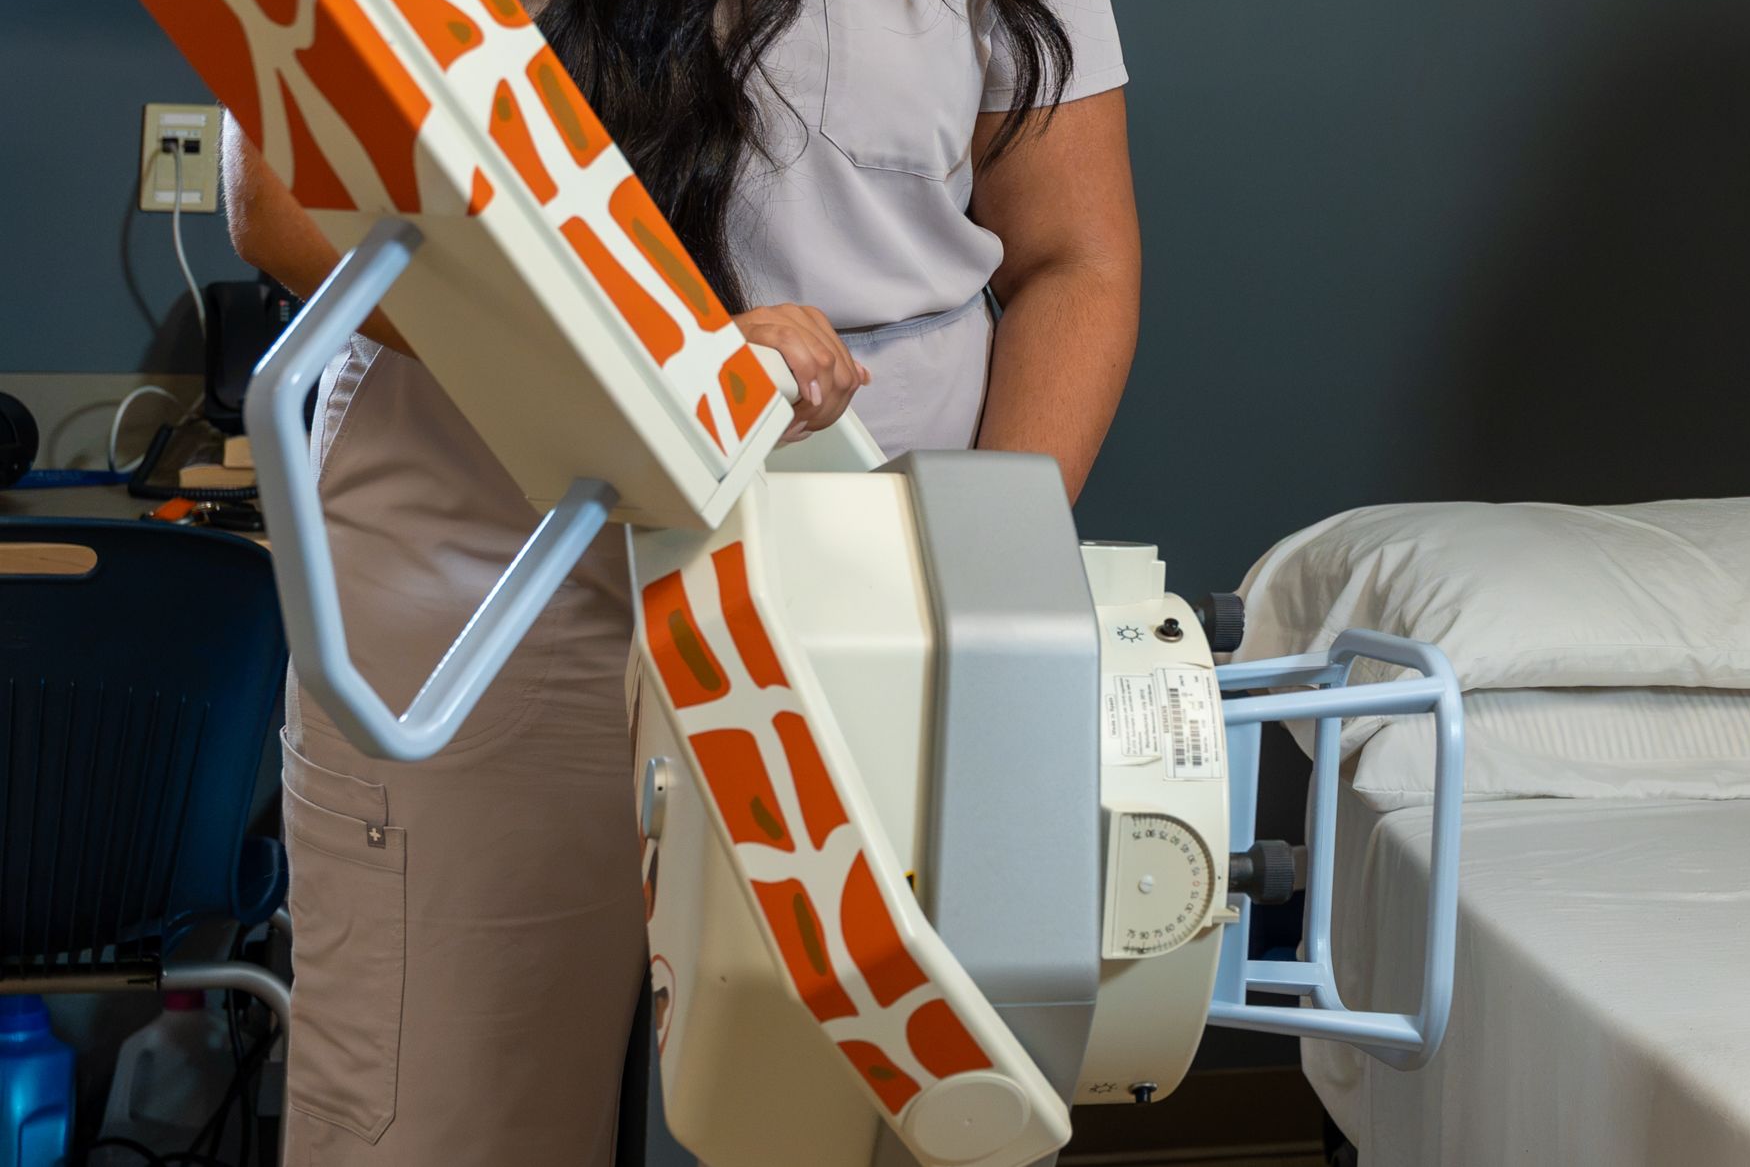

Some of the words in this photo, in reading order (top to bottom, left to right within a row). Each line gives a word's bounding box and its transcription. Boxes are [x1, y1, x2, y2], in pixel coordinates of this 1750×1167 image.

[1132, 832, 1141, 840] 75
[1146, 829, 1155, 838] 90
[1159, 831, 1168, 840] 75
[1170, 835, 1180, 845] 60
[1180, 843, 1190, 853] 45
[1187, 854, 1196, 865] 30
[1192, 866, 1200, 876] 15
[1190, 891, 1199, 899] 15
[1185, 903, 1194, 913] 30
[1177, 914, 1186, 923] 45
[1165, 923, 1175, 933] 60
[1127, 929, 1136, 938] 75
[1140, 931, 1150, 939] 90
[1154, 929, 1163, 938] 75
